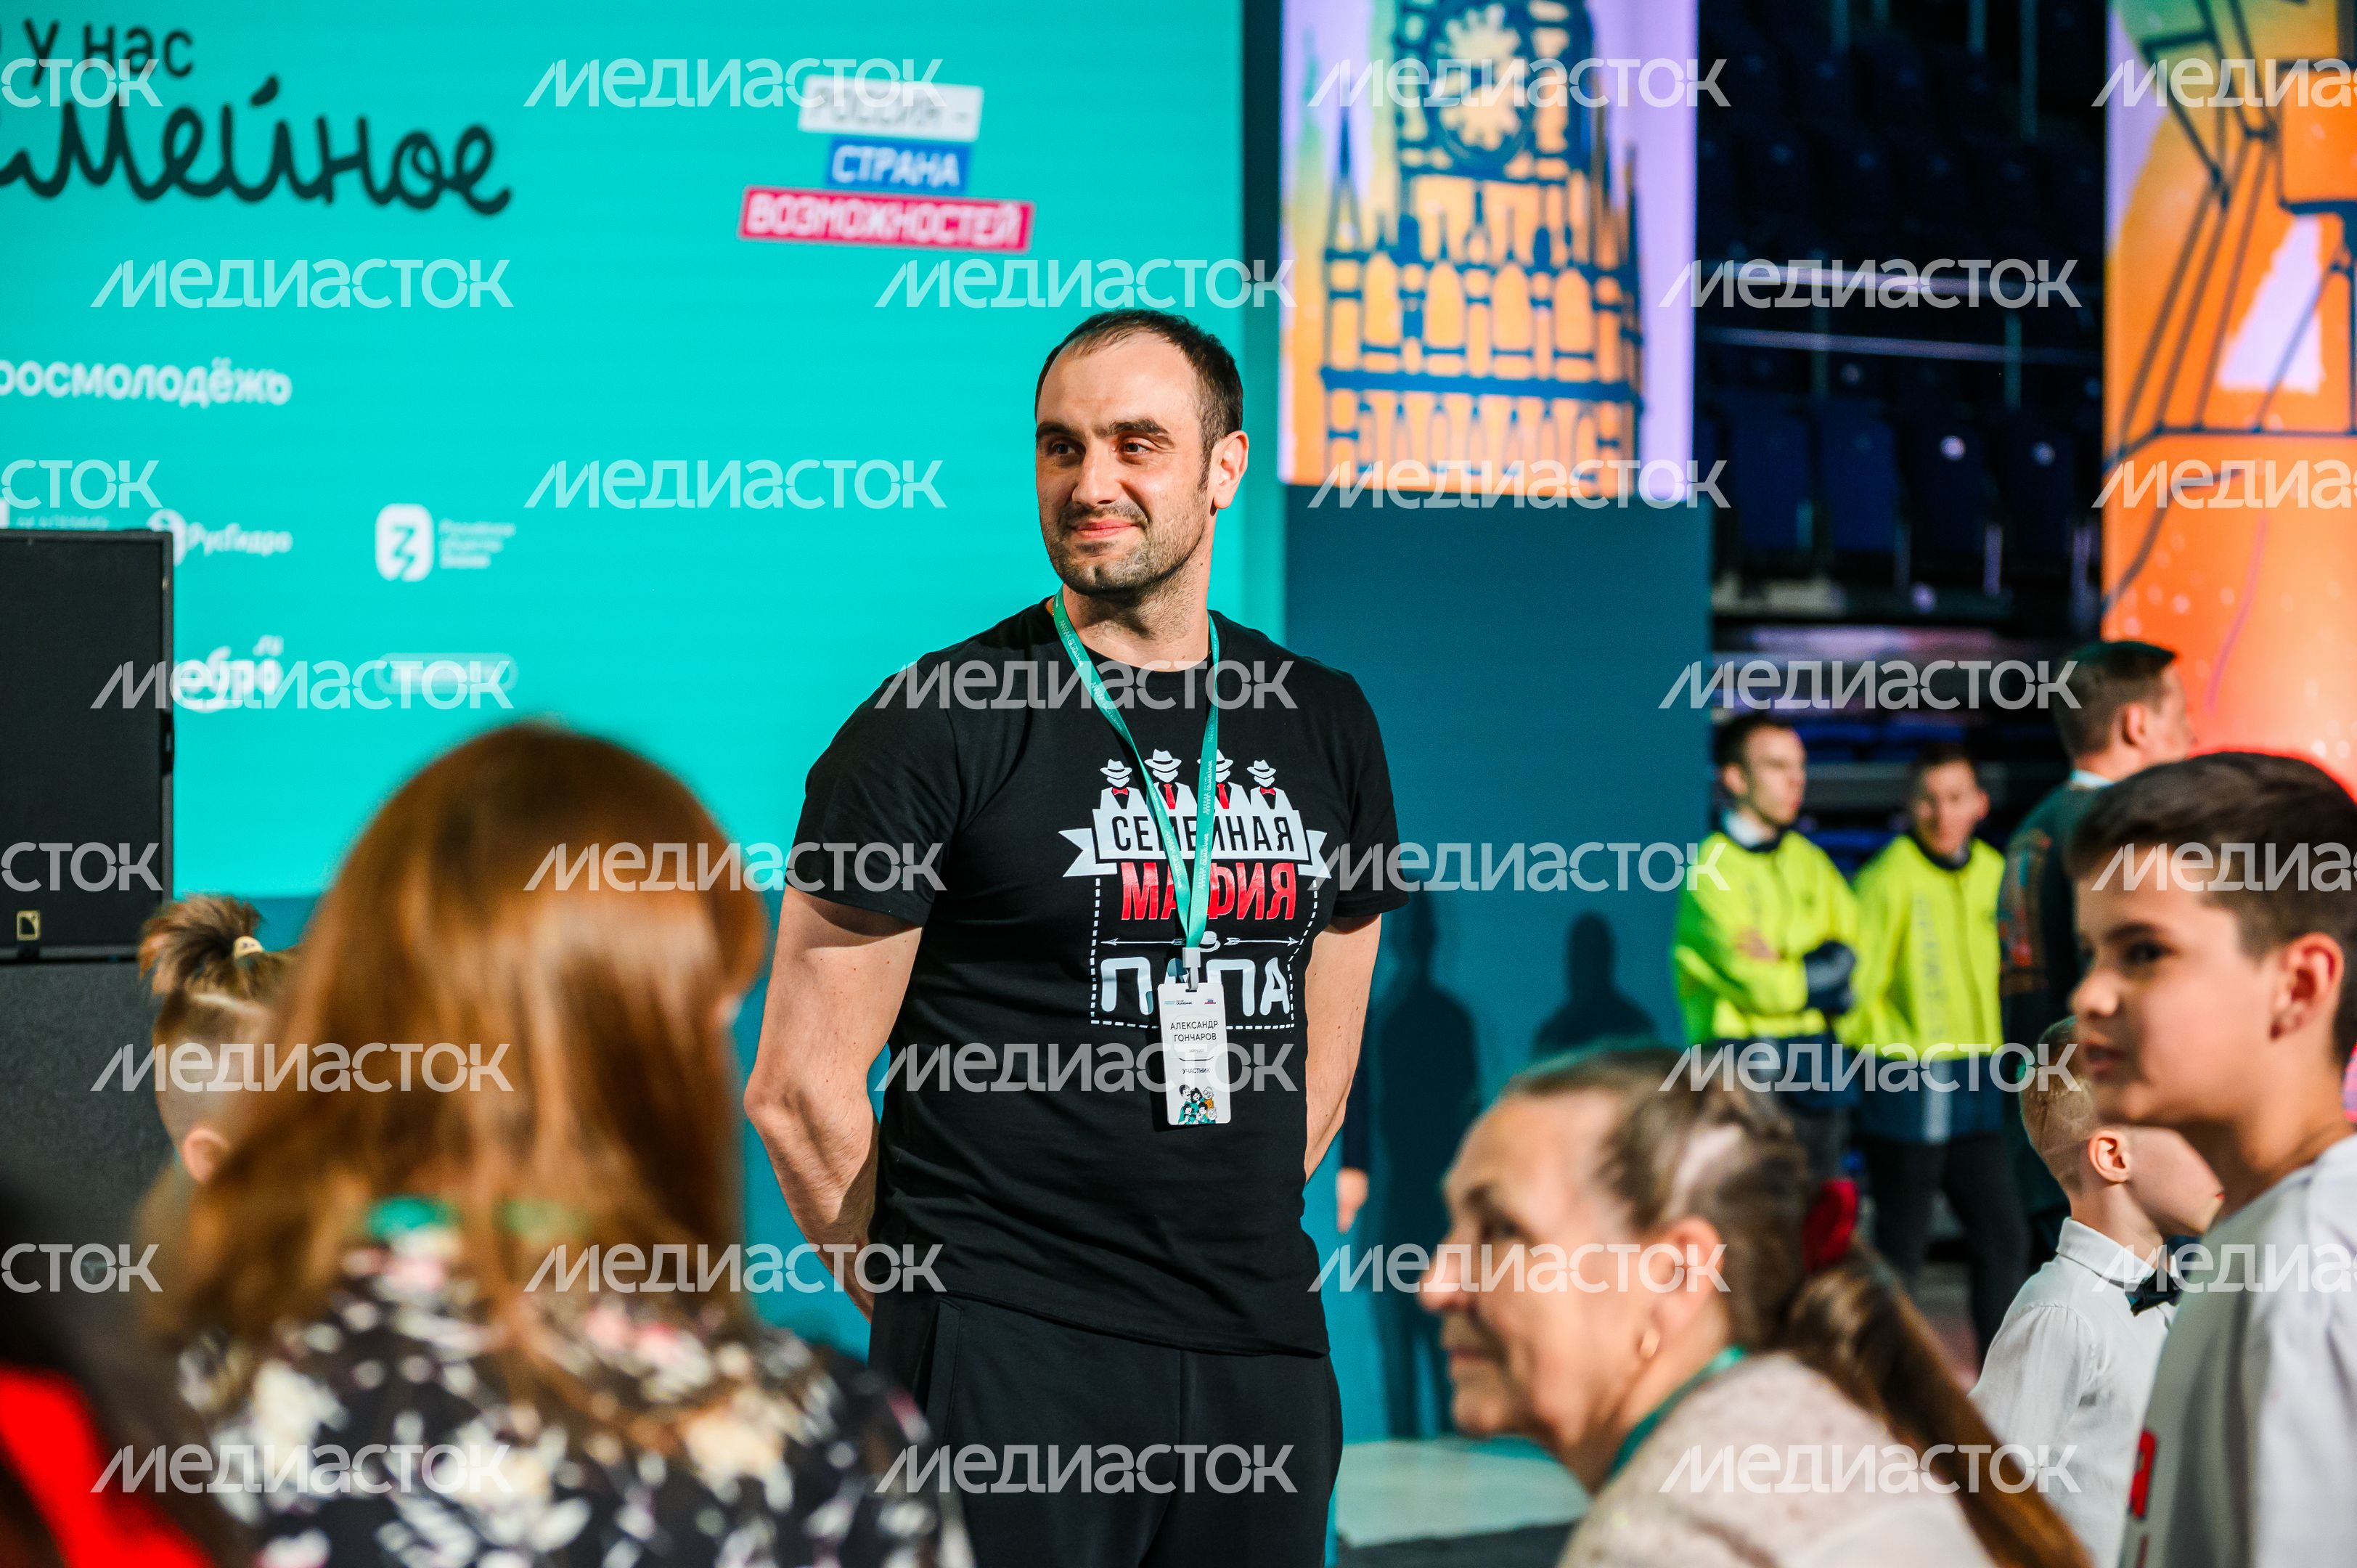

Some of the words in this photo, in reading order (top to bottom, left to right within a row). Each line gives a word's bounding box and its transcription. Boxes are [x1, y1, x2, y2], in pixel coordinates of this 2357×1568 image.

[24, 19, 60, 87] у
[83, 20, 195, 78] нас
[0, 73, 512, 219] мейное
[832, 144, 961, 189] СТРАНА
[746, 192, 1021, 246] ВОЗМОЖНОСТЕЙ
[1100, 956, 1291, 1017] ППА
[1170, 1020, 1219, 1030] АЛЕКСАНДР
[1174, 1032, 1217, 1042] ГОНЧАРОВ
